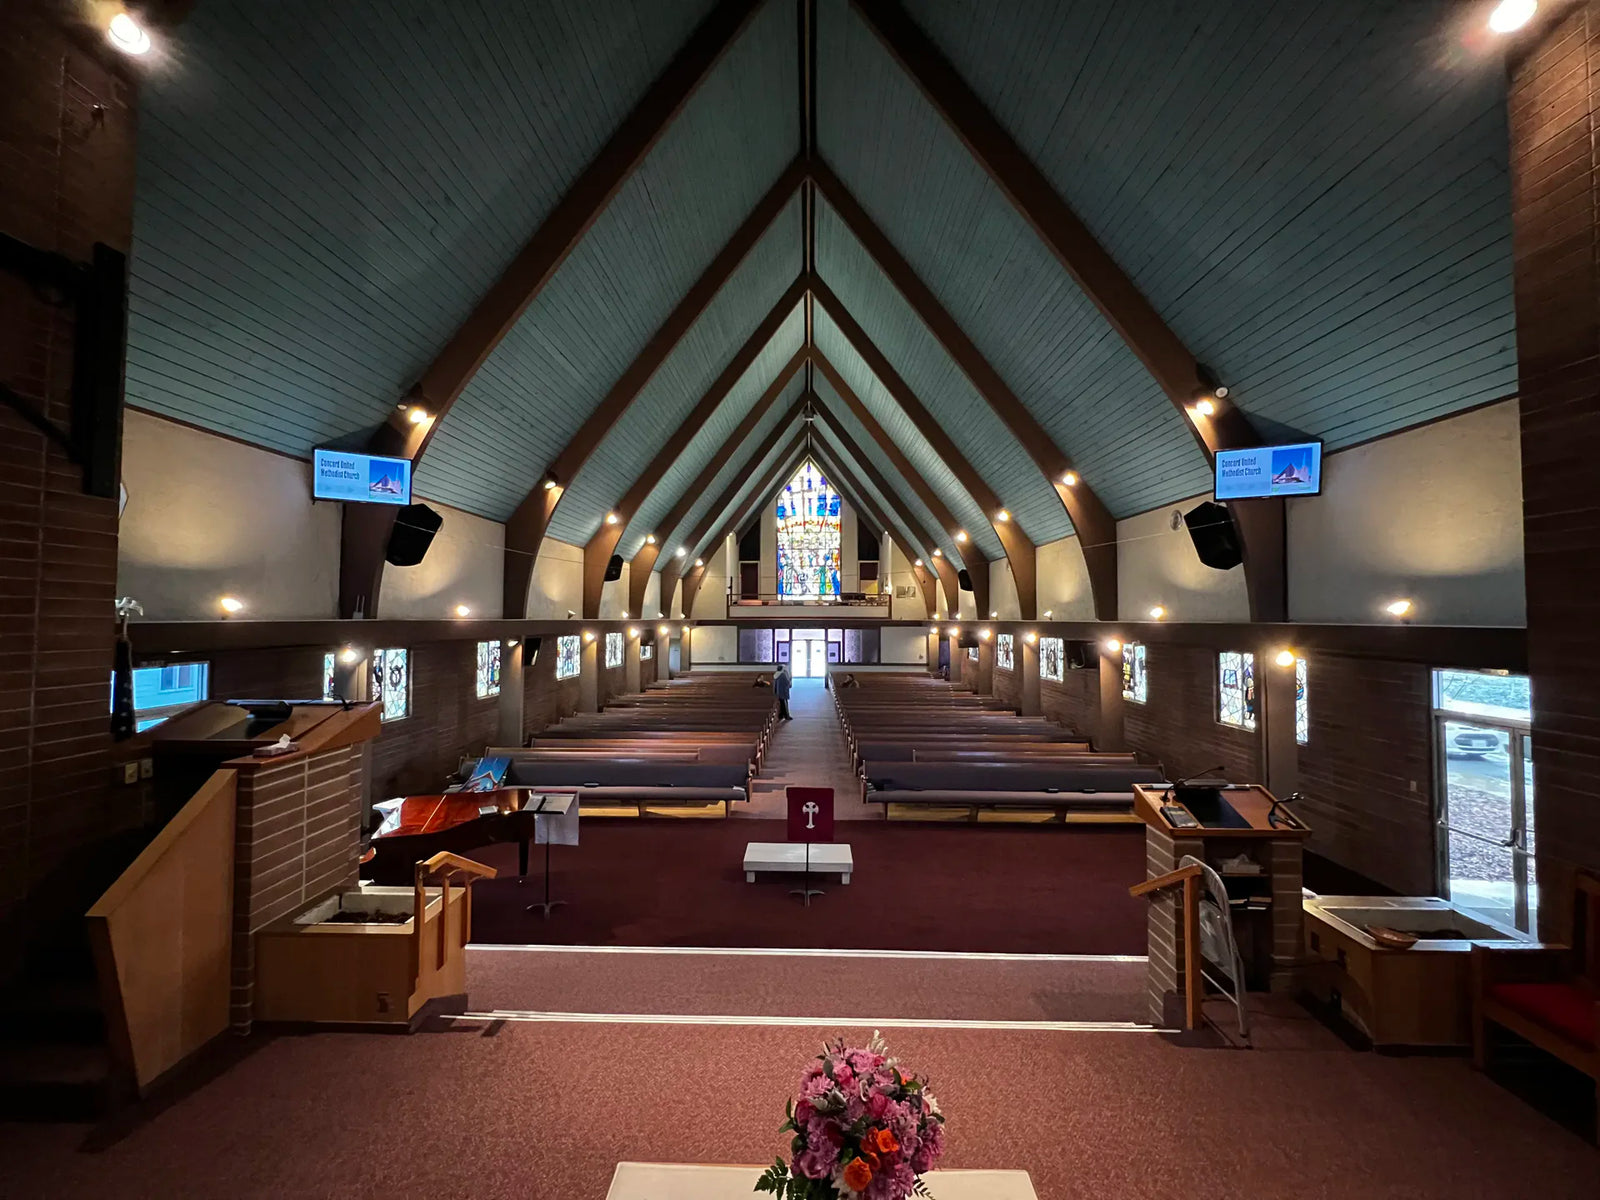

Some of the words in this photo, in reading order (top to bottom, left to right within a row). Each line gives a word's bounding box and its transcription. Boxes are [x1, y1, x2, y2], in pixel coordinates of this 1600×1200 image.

[320, 458, 340, 468] Concord
[341, 460, 355, 470] United
[1222, 459, 1241, 468] Concord
[1241, 457, 1257, 466] United
[320, 468, 344, 479] Methodist
[344, 470, 360, 480] Church
[1222, 468, 1244, 478] Methodist
[1244, 467, 1261, 476] Church
